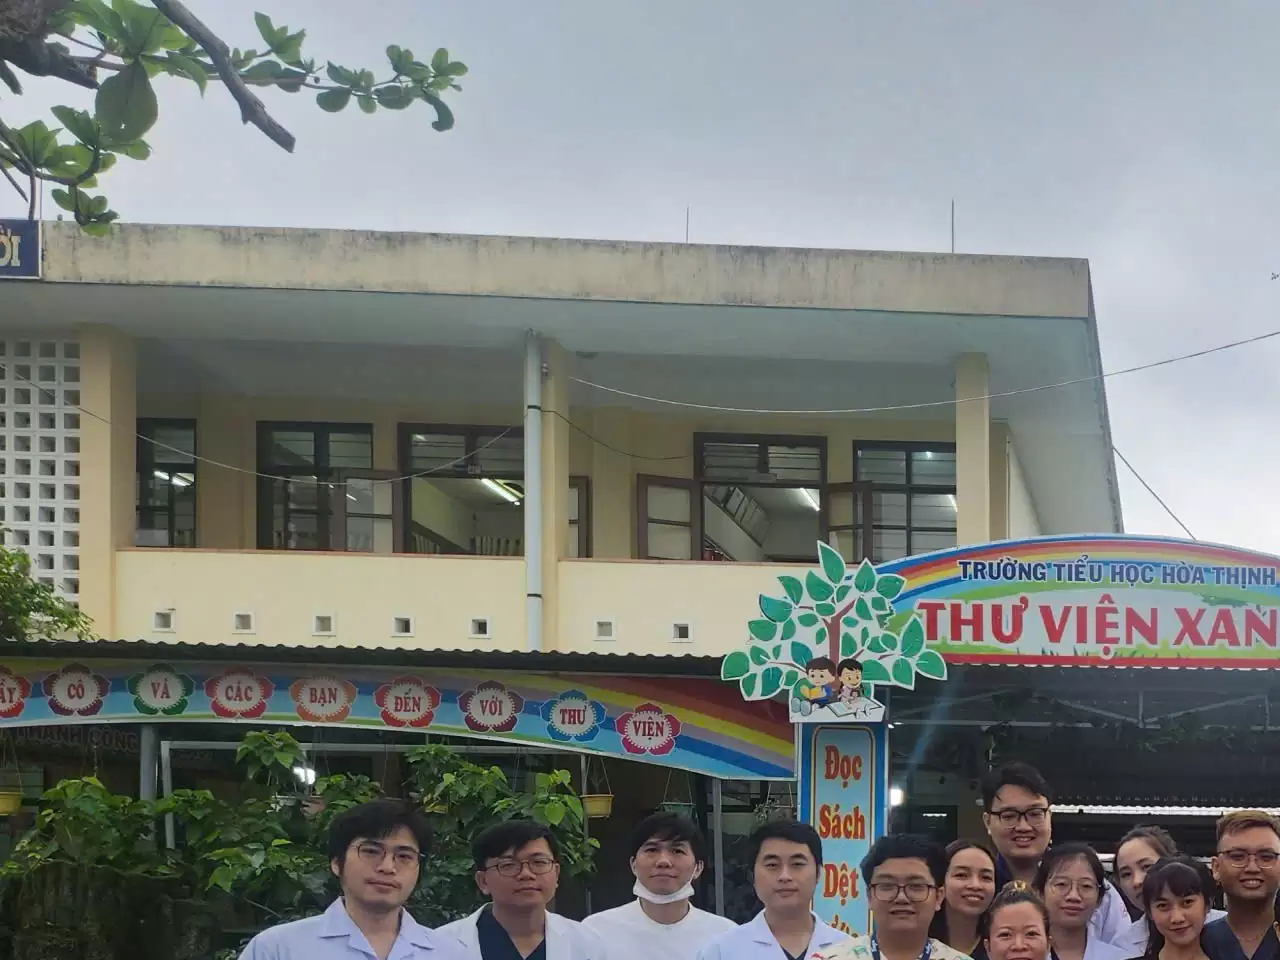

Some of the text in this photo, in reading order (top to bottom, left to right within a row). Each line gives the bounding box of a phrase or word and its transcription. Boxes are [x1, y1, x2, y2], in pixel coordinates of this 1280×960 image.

[958, 554, 1276, 590] TRƯỜNG TIỂU HỌC HÒA THỊNH
[917, 595, 1030, 644] THƯ
[1038, 594, 1158, 659] VIỆN
[225, 680, 253, 702] CÁC
[310, 687, 338, 707] BẠN
[394, 688, 422, 713] ĐẾN
[479, 695, 503, 716] VỚI
[559, 707, 587, 726] THƯ
[633, 716, 665, 741] VIỆN
[824, 745, 862, 788] Đọc
[819, 803, 865, 840] Sách
[823, 863, 859, 906] Dệt
